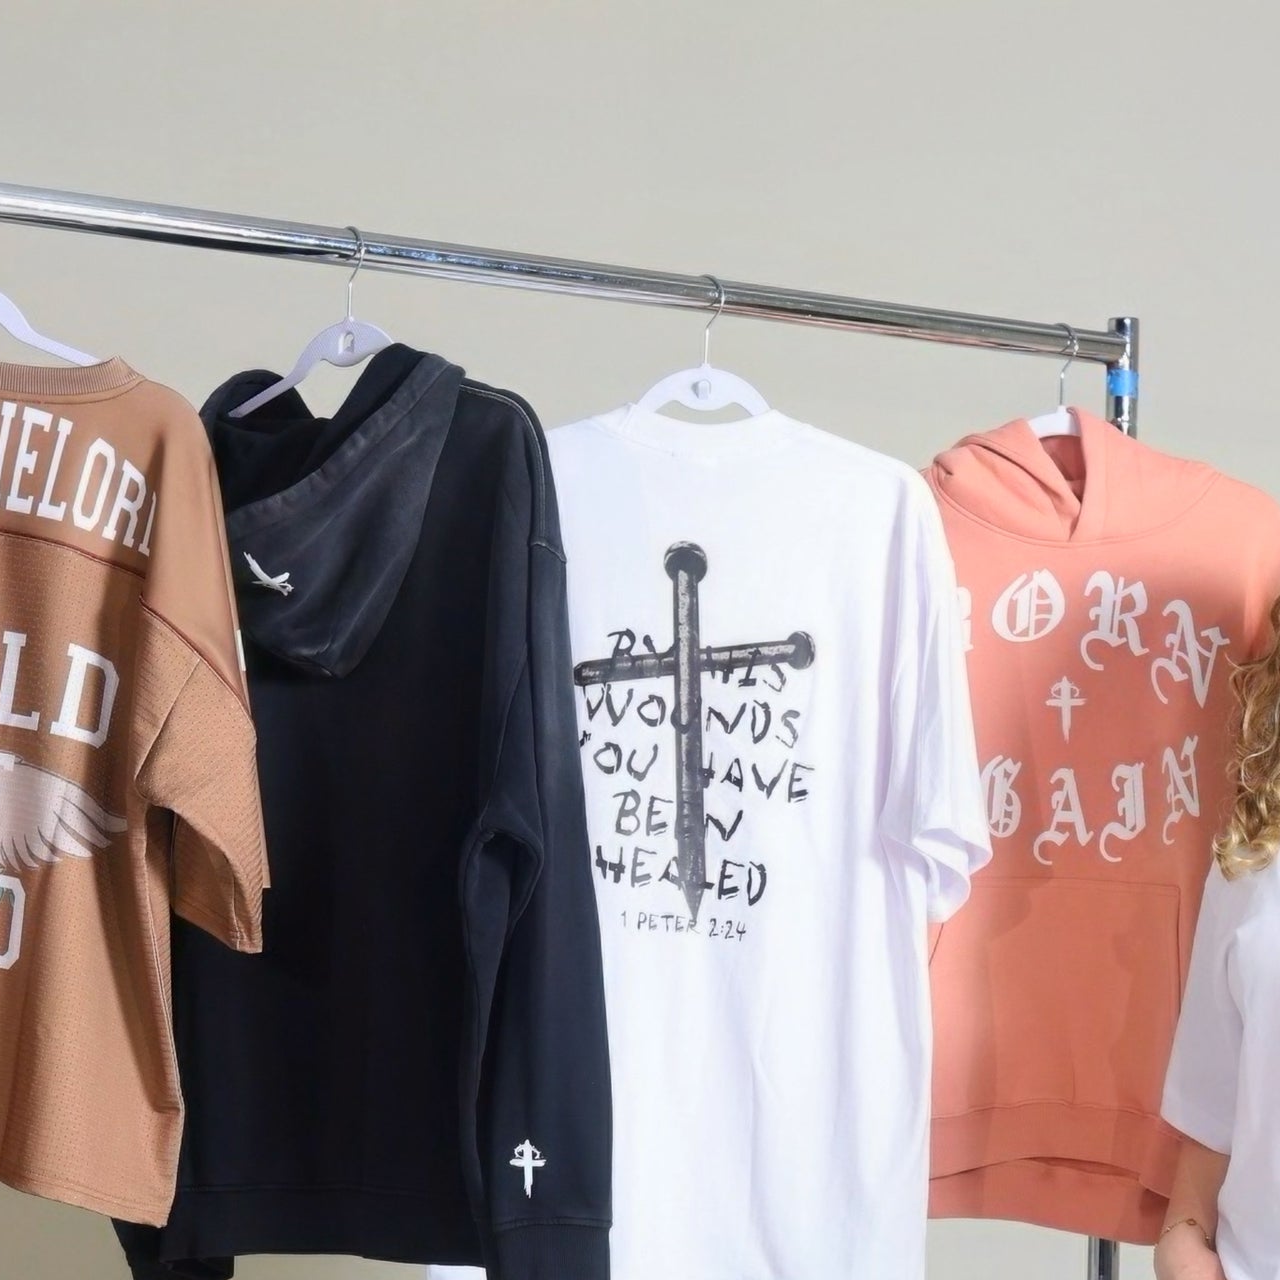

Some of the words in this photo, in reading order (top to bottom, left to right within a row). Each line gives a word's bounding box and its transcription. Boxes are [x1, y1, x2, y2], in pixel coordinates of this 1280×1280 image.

[579, 731, 659, 782] OU
[612, 789, 744, 842] BEN
[980, 735, 1200, 865] GAIN
[636, 911, 701, 934] PETER
[708, 918, 747, 942] 2:24
